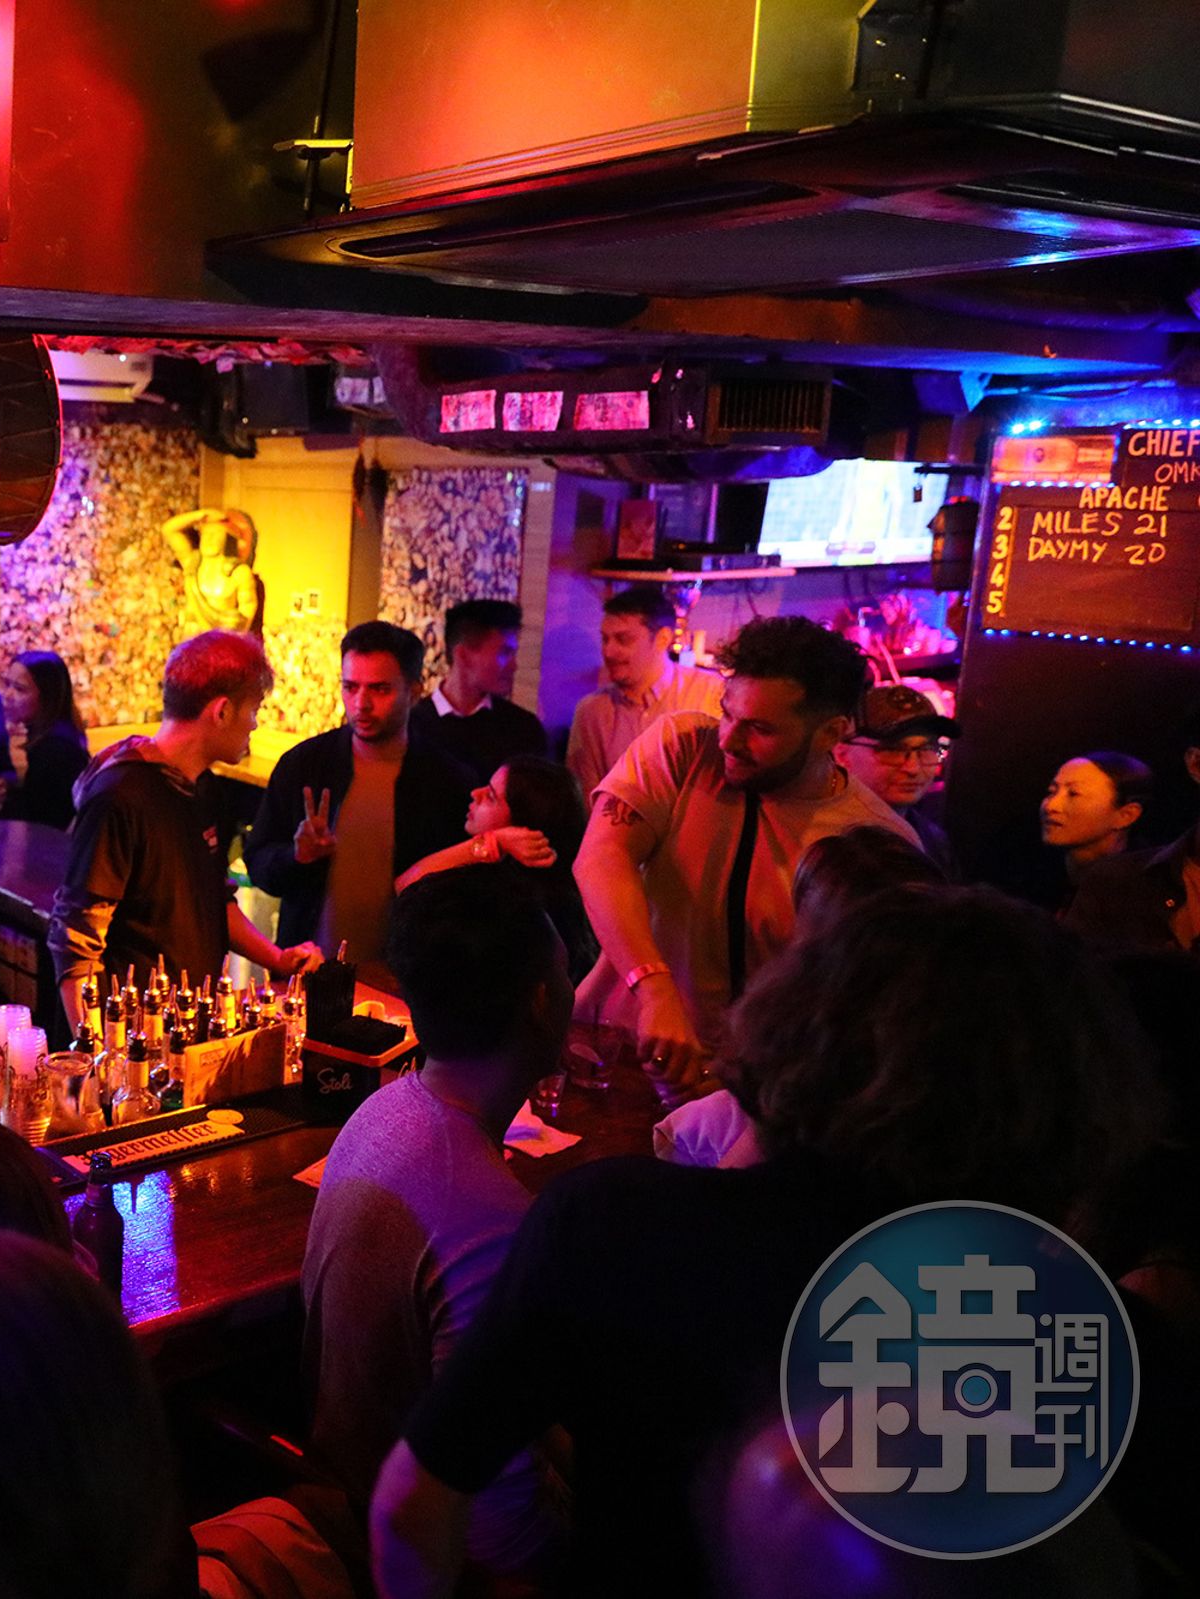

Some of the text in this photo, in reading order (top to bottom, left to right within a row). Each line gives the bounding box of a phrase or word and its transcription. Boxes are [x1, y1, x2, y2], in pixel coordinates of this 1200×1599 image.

[1128, 430, 1200, 457] CHIEF
[1079, 485, 1171, 511] APACHE
[997, 506, 1167, 538] 2 MILES 21
[992, 535, 1009, 560] 3
[1124, 542, 1166, 565] 20
[990, 563, 1005, 588] 4
[986, 591, 1003, 613] 5
